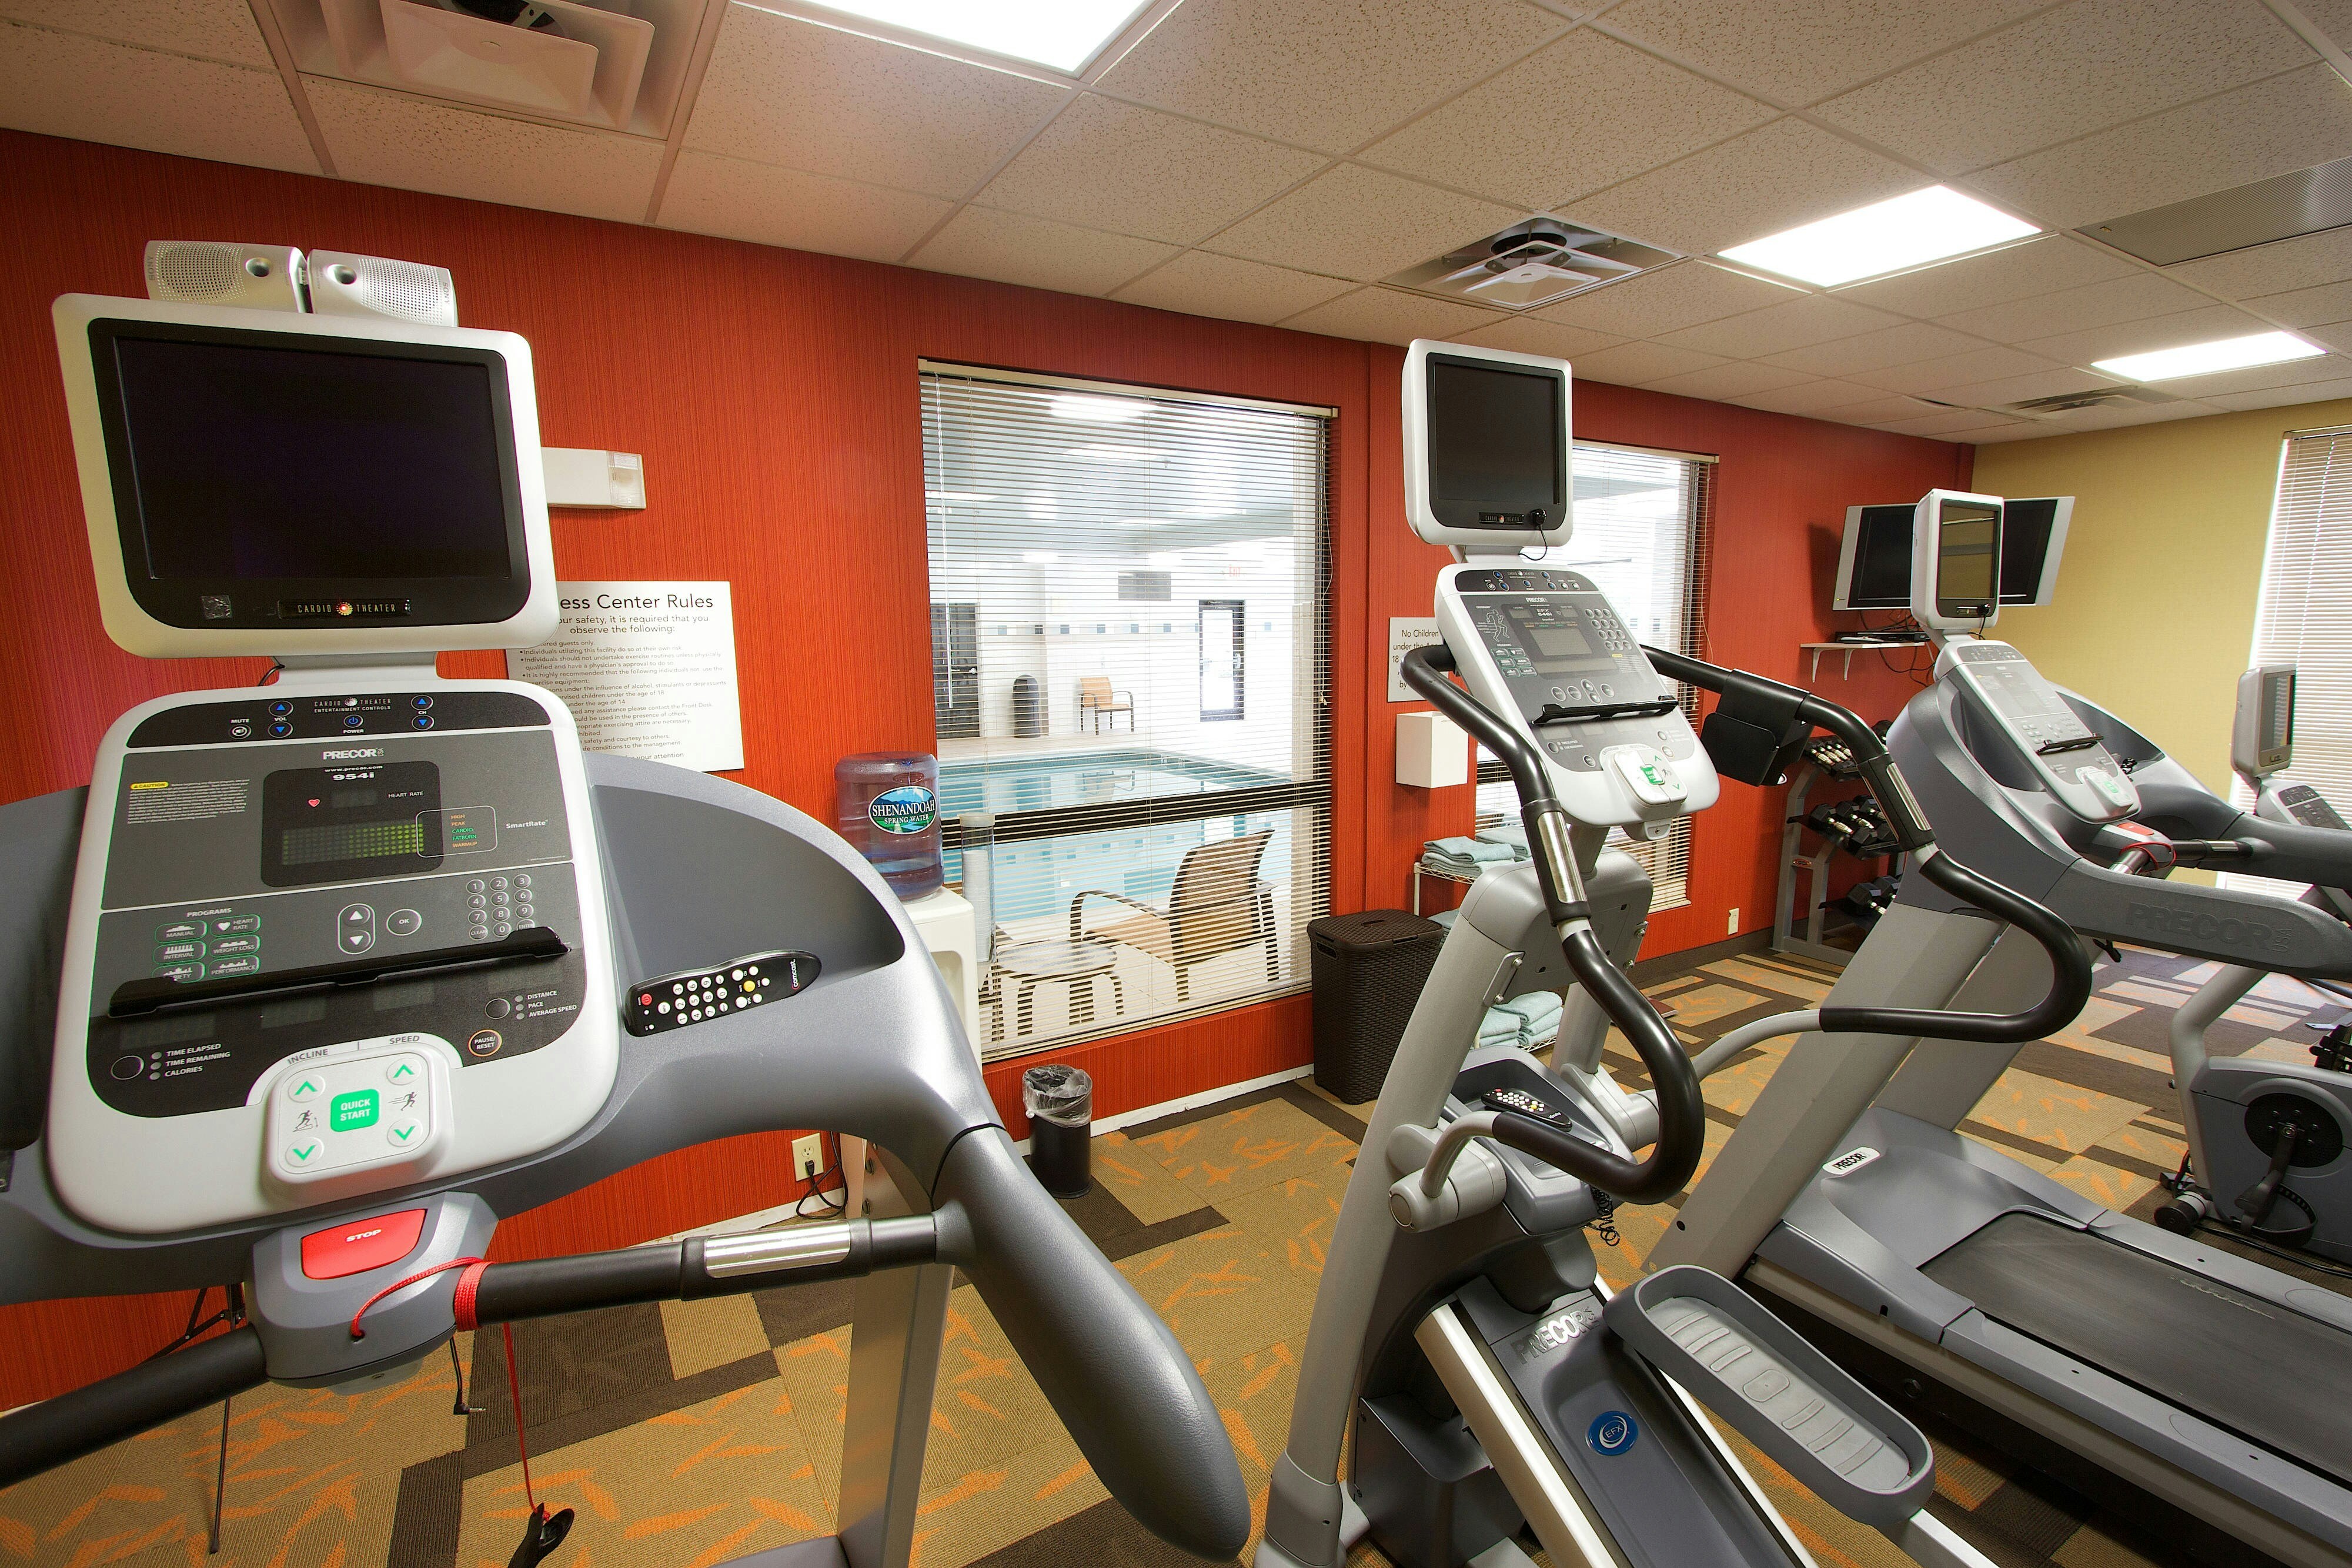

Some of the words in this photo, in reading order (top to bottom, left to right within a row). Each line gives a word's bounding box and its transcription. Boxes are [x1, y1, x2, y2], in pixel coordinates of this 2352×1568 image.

[147, 255, 155, 281] SONY
[442, 281, 450, 305] SONY
[560, 599, 590, 609] ess
[597, 594, 660, 609] Center
[667, 594, 713, 608] Rules
[298, 604, 332, 613] CARDIO
[356, 604, 396, 612] THEATER
[576, 616, 606, 625] safety,
[630, 614, 669, 623] required
[630, 625, 675, 634] following:
[1399, 681, 1406, 690] by
[323, 749, 376, 760] PRECOR
[333, 771, 375, 780] 954i
[872, 800, 935, 817] SHENANDOAH
[910, 814, 929, 822] WATER
[187, 908, 232, 917] PROGRAMS
[2126, 902, 2273, 950] PRECOR
[2272, 928, 2292, 953] USA
[211, 965, 255, 975] PERFORMANCE
[527, 990, 557, 999] DISTANCE
[529, 1008, 557, 1017] AVERAGE
[389, 1035, 420, 1044] SPEED
[186, 1044, 221, 1054] ELAPSED
[186, 1051, 231, 1064] REMAINING
[288, 1048, 328, 1065] INCLINE
[165, 1066, 203, 1077] CALORIES
[340, 1098, 370, 1111] QUICK
[340, 1108, 371, 1121] START
[1832, 1153, 1867, 1170] PRECOR
[346, 1229, 382, 1242] STOP
[1510, 1310, 1587, 1365] PRECOR
[1605, 1425, 1623, 1439] EFX
